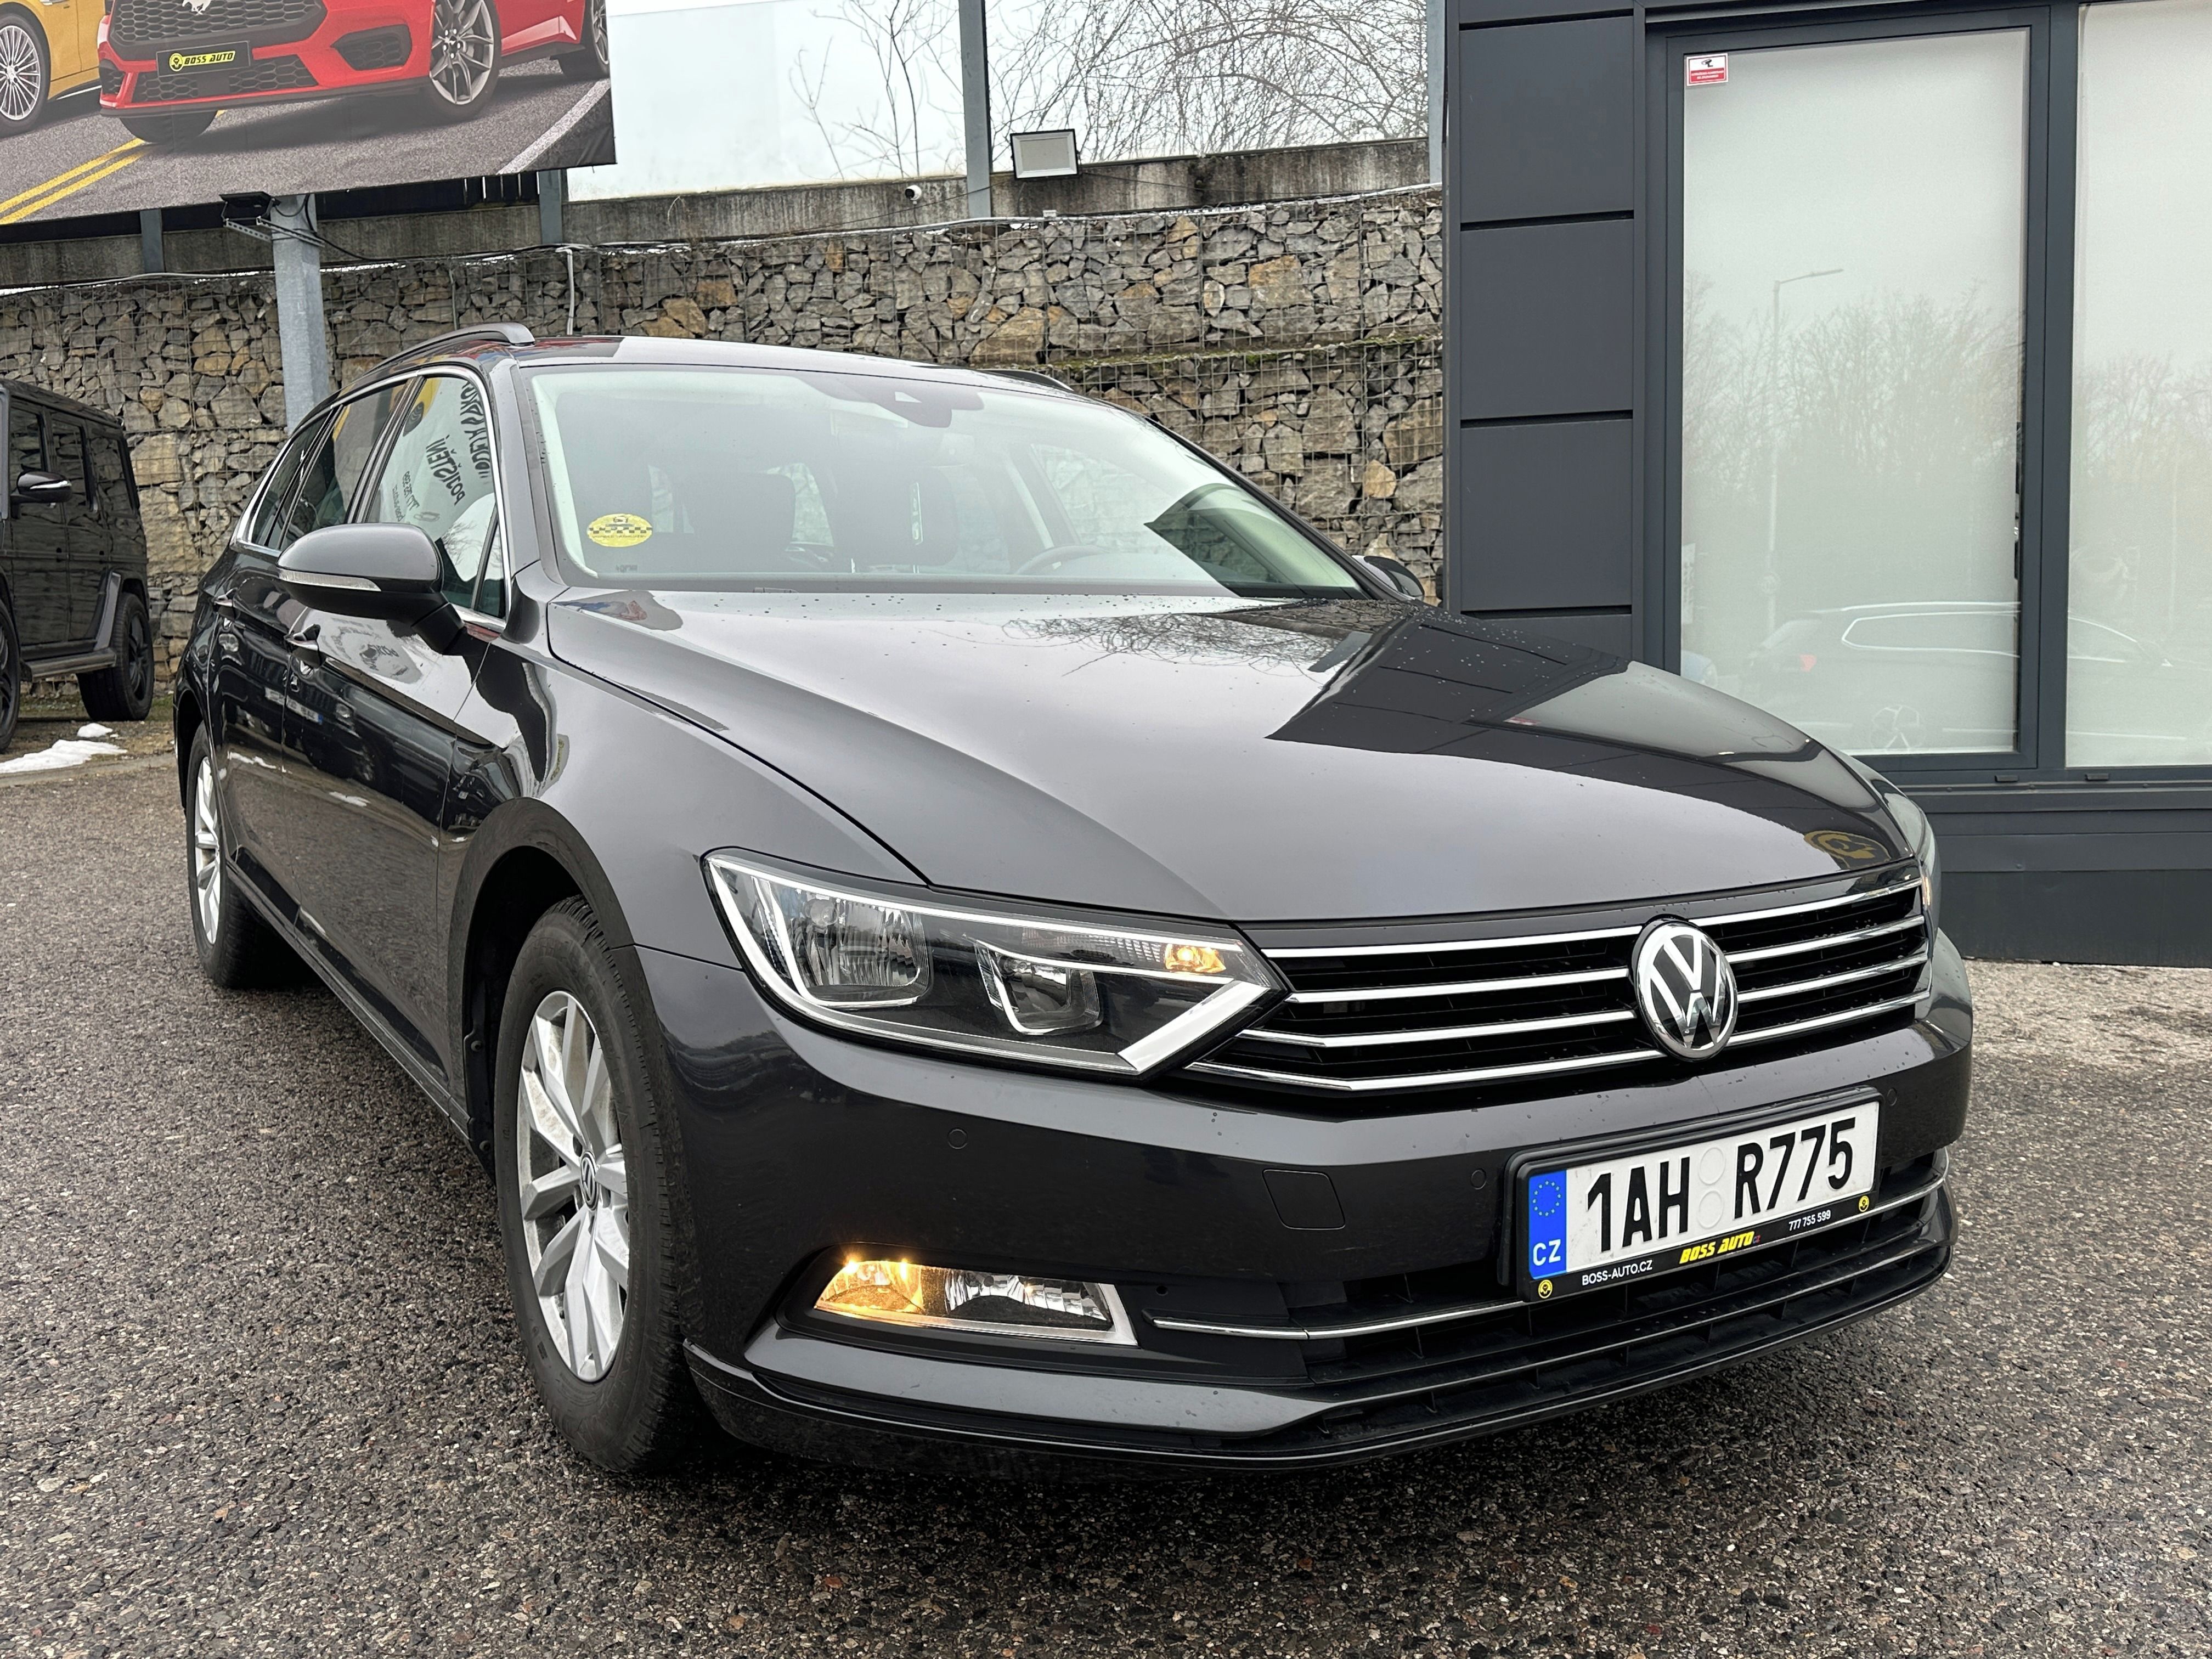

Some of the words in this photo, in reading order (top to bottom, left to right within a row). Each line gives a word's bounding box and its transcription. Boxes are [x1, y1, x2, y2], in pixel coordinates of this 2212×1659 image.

[184, 55, 207, 65] BOSS
[209, 52, 234, 62] AUTO
[1587, 1156, 1690, 1252] 1AH
[1734, 1117, 1856, 1219] R775
[1788, 1218, 1802, 1231] 777
[1802, 1214, 1816, 1227] 755
[1817, 1210, 1831, 1222] 599
[1532, 1239, 1561, 1266] CZ
[1679, 1242, 1717, 1264] BOSS
[1717, 1231, 1755, 1254] AUTO
[1582, 1260, 1653, 1286] BOSS-AUTO.CZ
